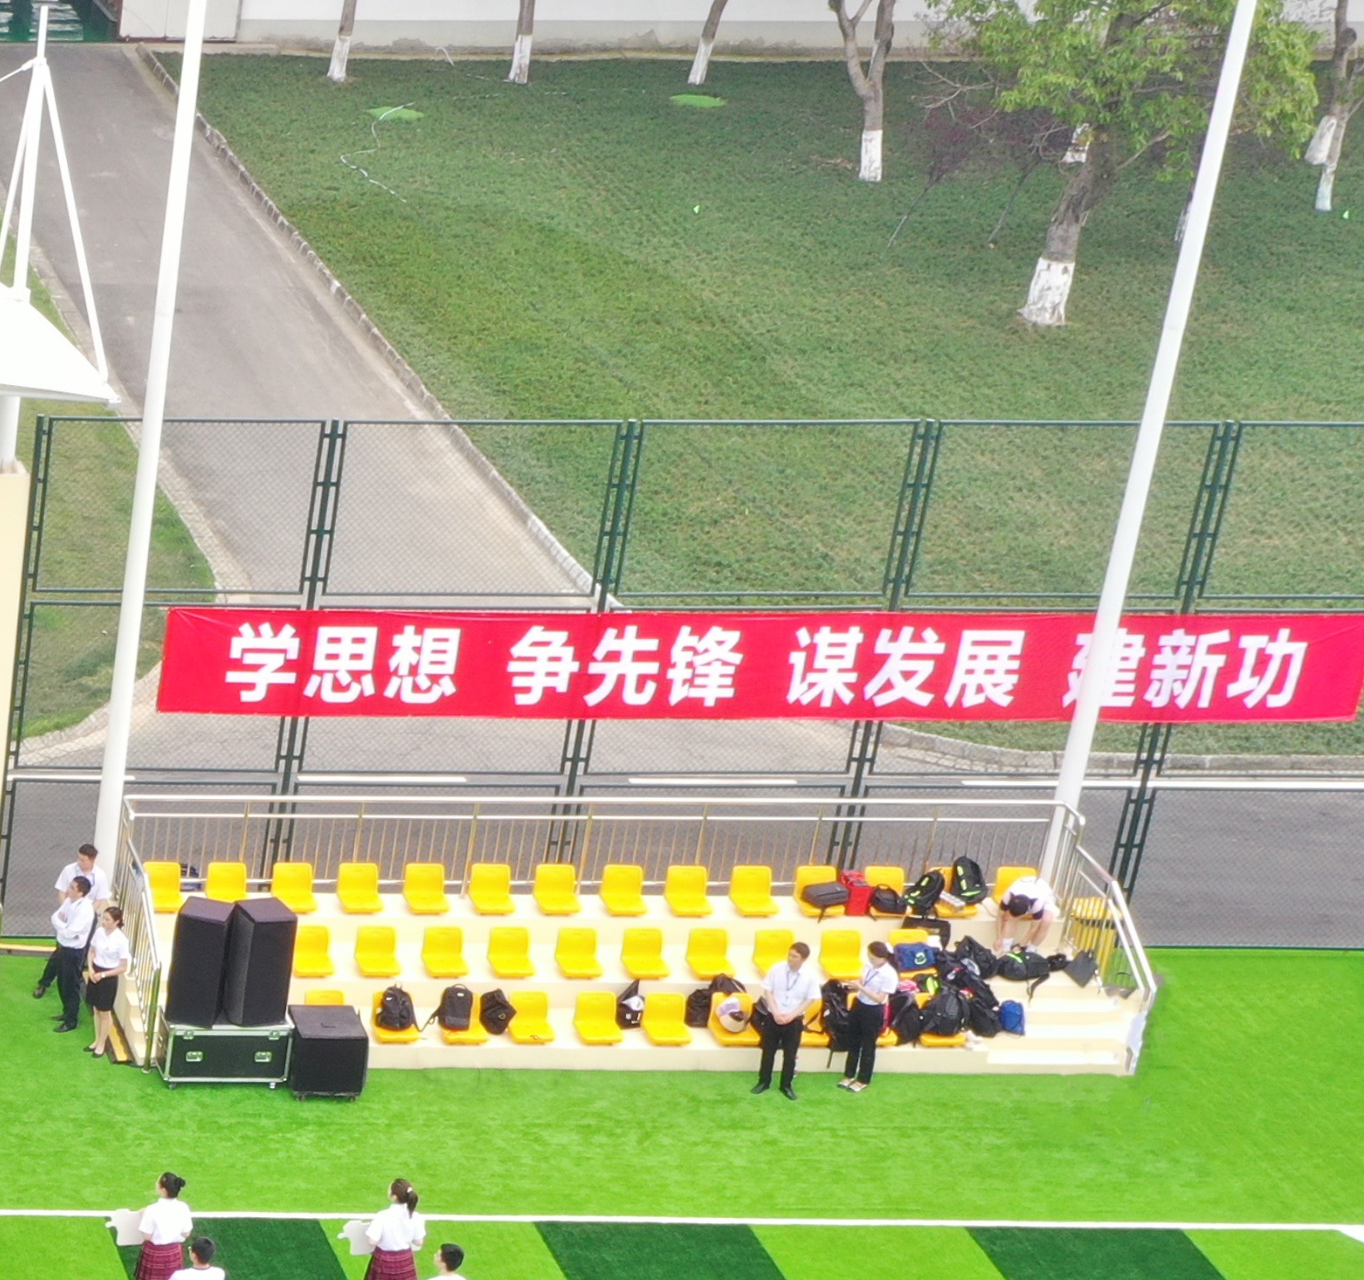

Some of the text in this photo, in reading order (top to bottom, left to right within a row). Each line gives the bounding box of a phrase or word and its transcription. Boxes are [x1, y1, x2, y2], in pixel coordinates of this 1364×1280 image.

[224, 622, 1308, 709] 学思想 争先锋 谋发展 建新功
